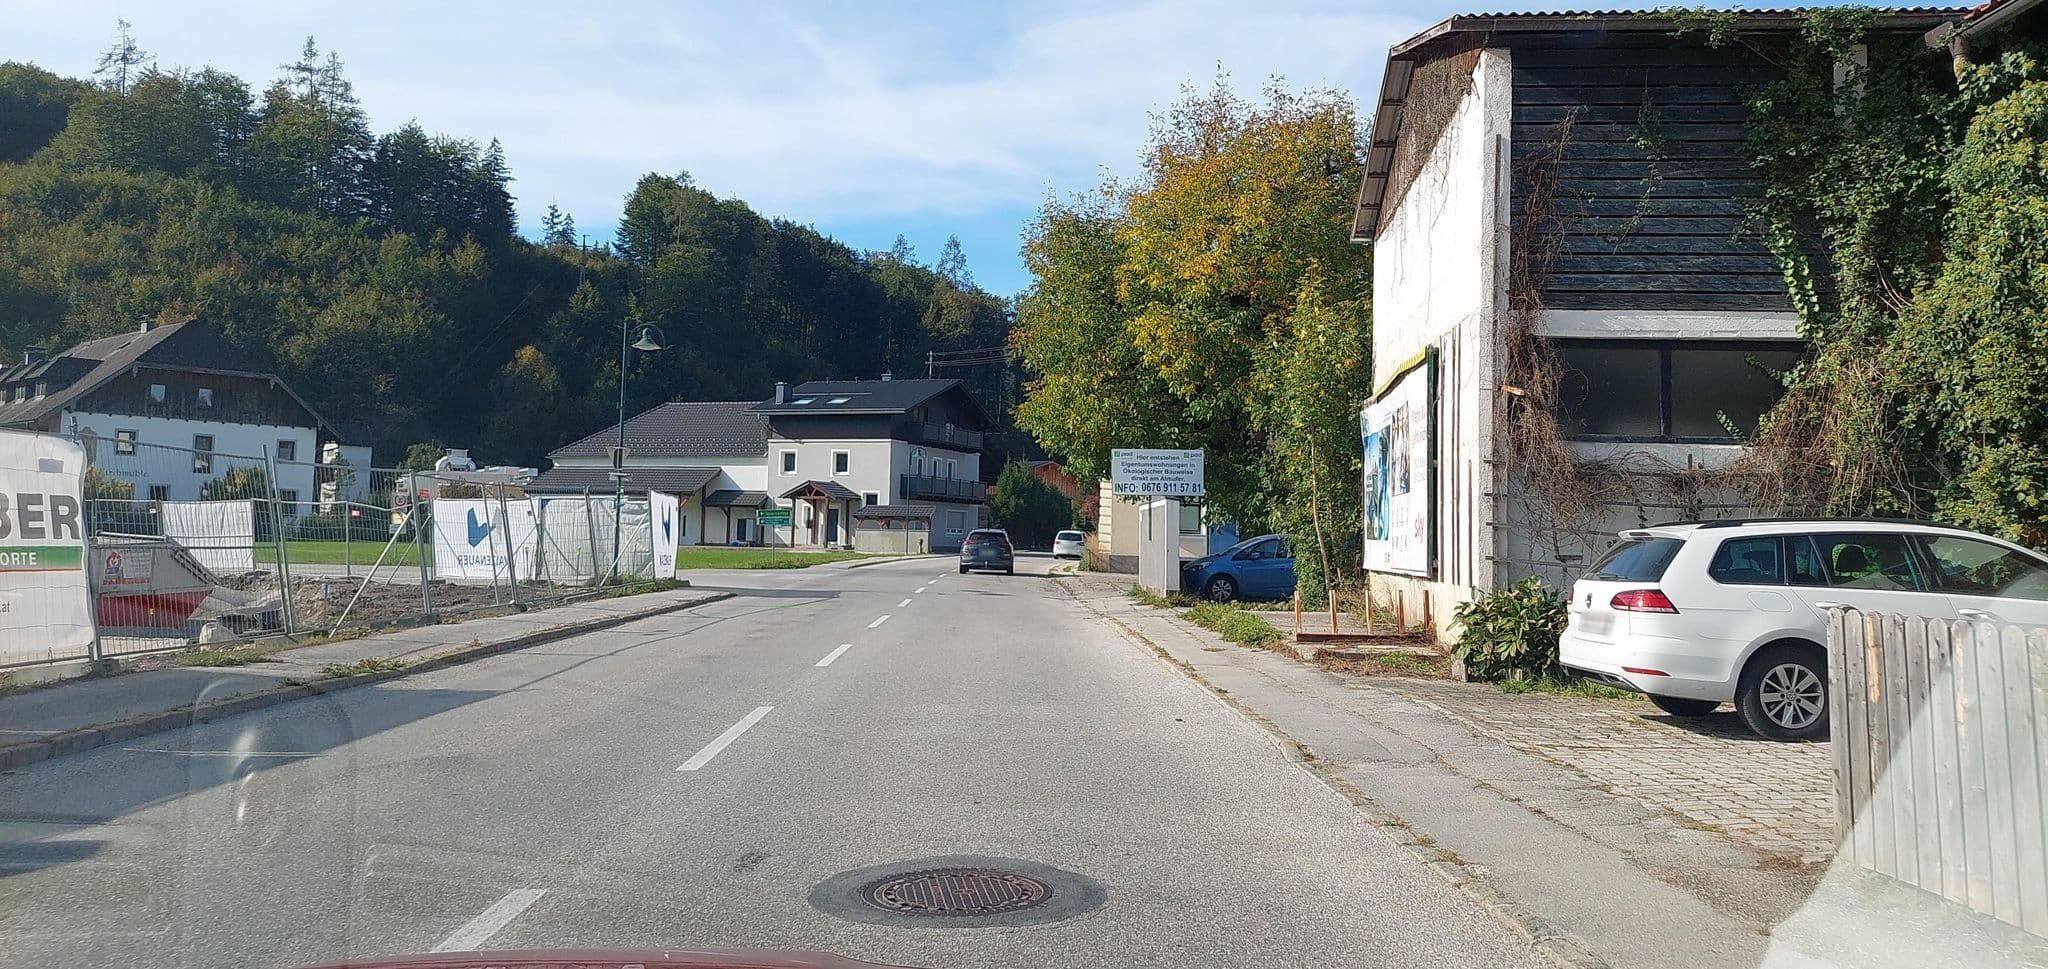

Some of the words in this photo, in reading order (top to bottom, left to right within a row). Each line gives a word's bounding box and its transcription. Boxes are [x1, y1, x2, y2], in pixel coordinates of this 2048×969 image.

[1115, 483, 1138, 493] INFO:
[1141, 482, 1161, 492] 0676
[1163, 482, 1177, 492] 911
[1180, 483, 1189, 492] 57
[1192, 483, 1201, 492] 81
